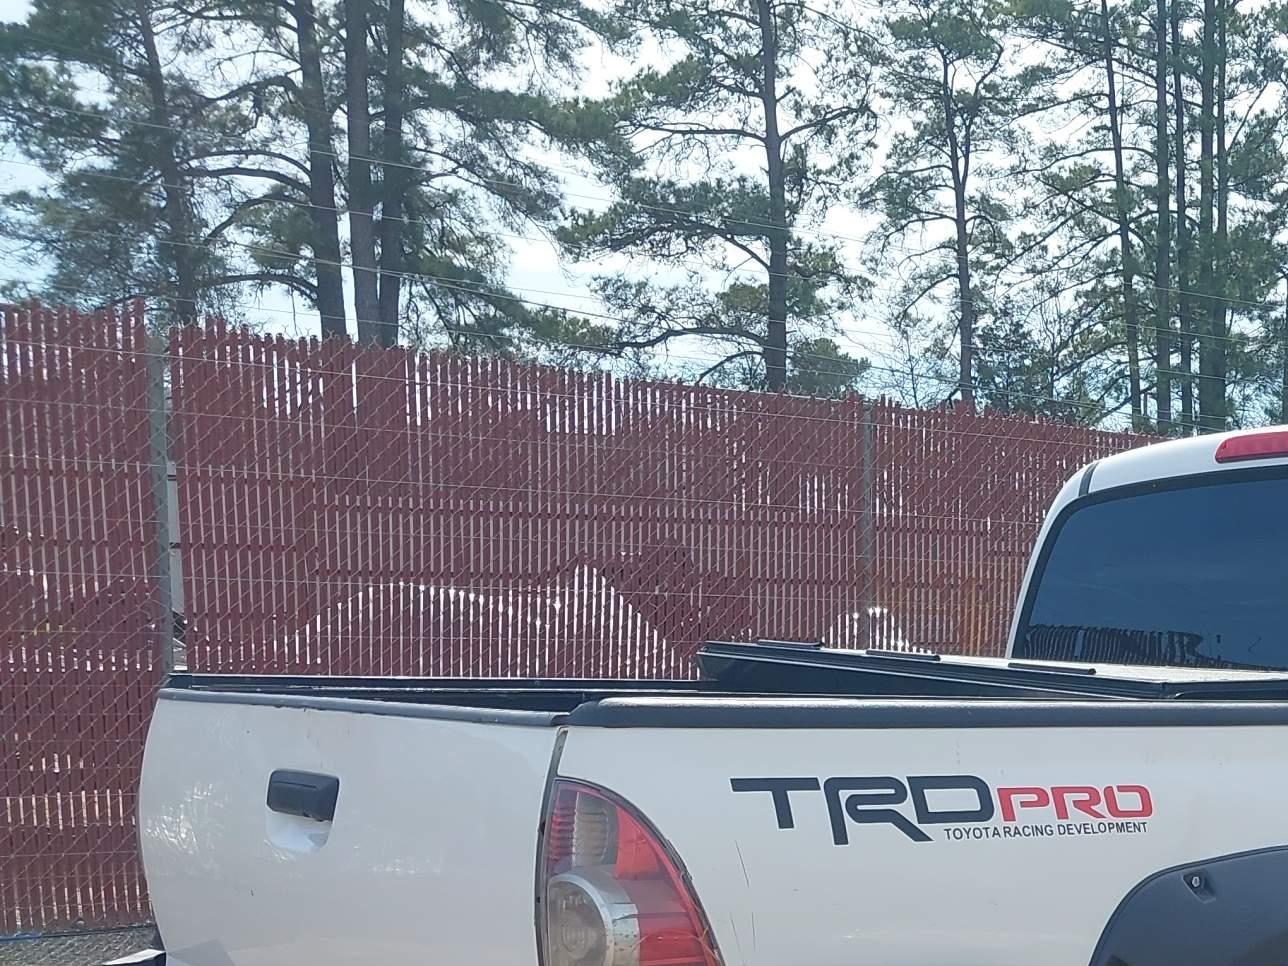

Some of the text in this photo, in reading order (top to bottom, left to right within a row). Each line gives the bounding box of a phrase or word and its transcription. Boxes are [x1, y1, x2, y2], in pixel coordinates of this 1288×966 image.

[730, 775, 1154, 846] TRD PRO
[943, 821, 1148, 841] TOYOTA RACING DEVELOPMENT
